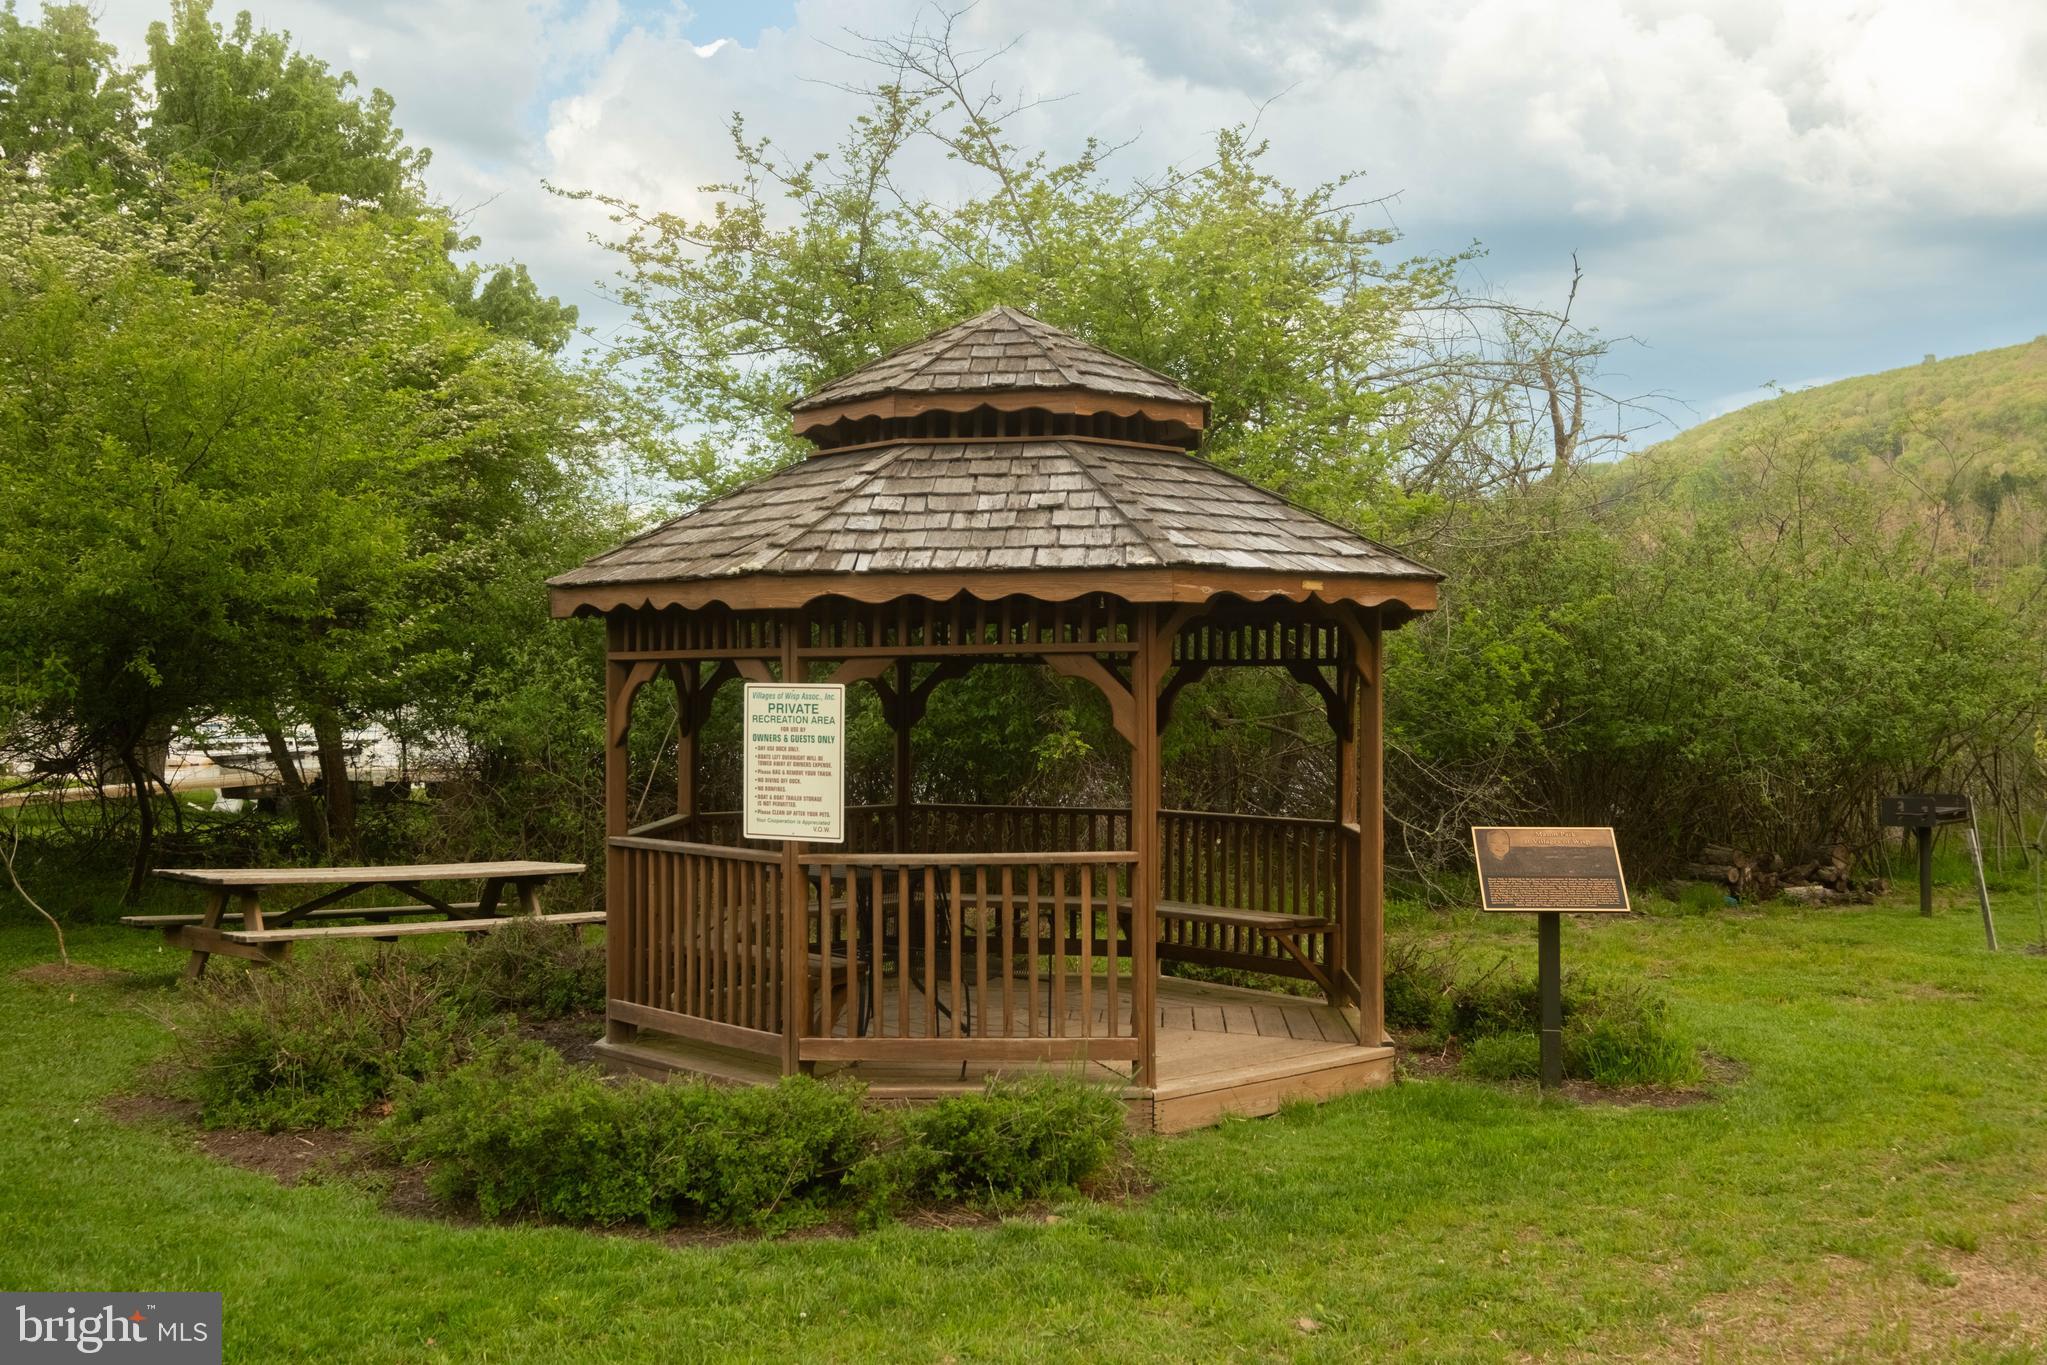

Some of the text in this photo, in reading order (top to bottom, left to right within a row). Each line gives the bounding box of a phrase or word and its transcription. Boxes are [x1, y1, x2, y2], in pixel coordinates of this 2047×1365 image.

[753, 692, 775, 700] Villages
[768, 703, 819, 714] PRIVATE
[752, 715, 808, 724] RECREATION
[753, 734, 781, 742] OWNERS
[791, 735, 815, 743] GUESTS
